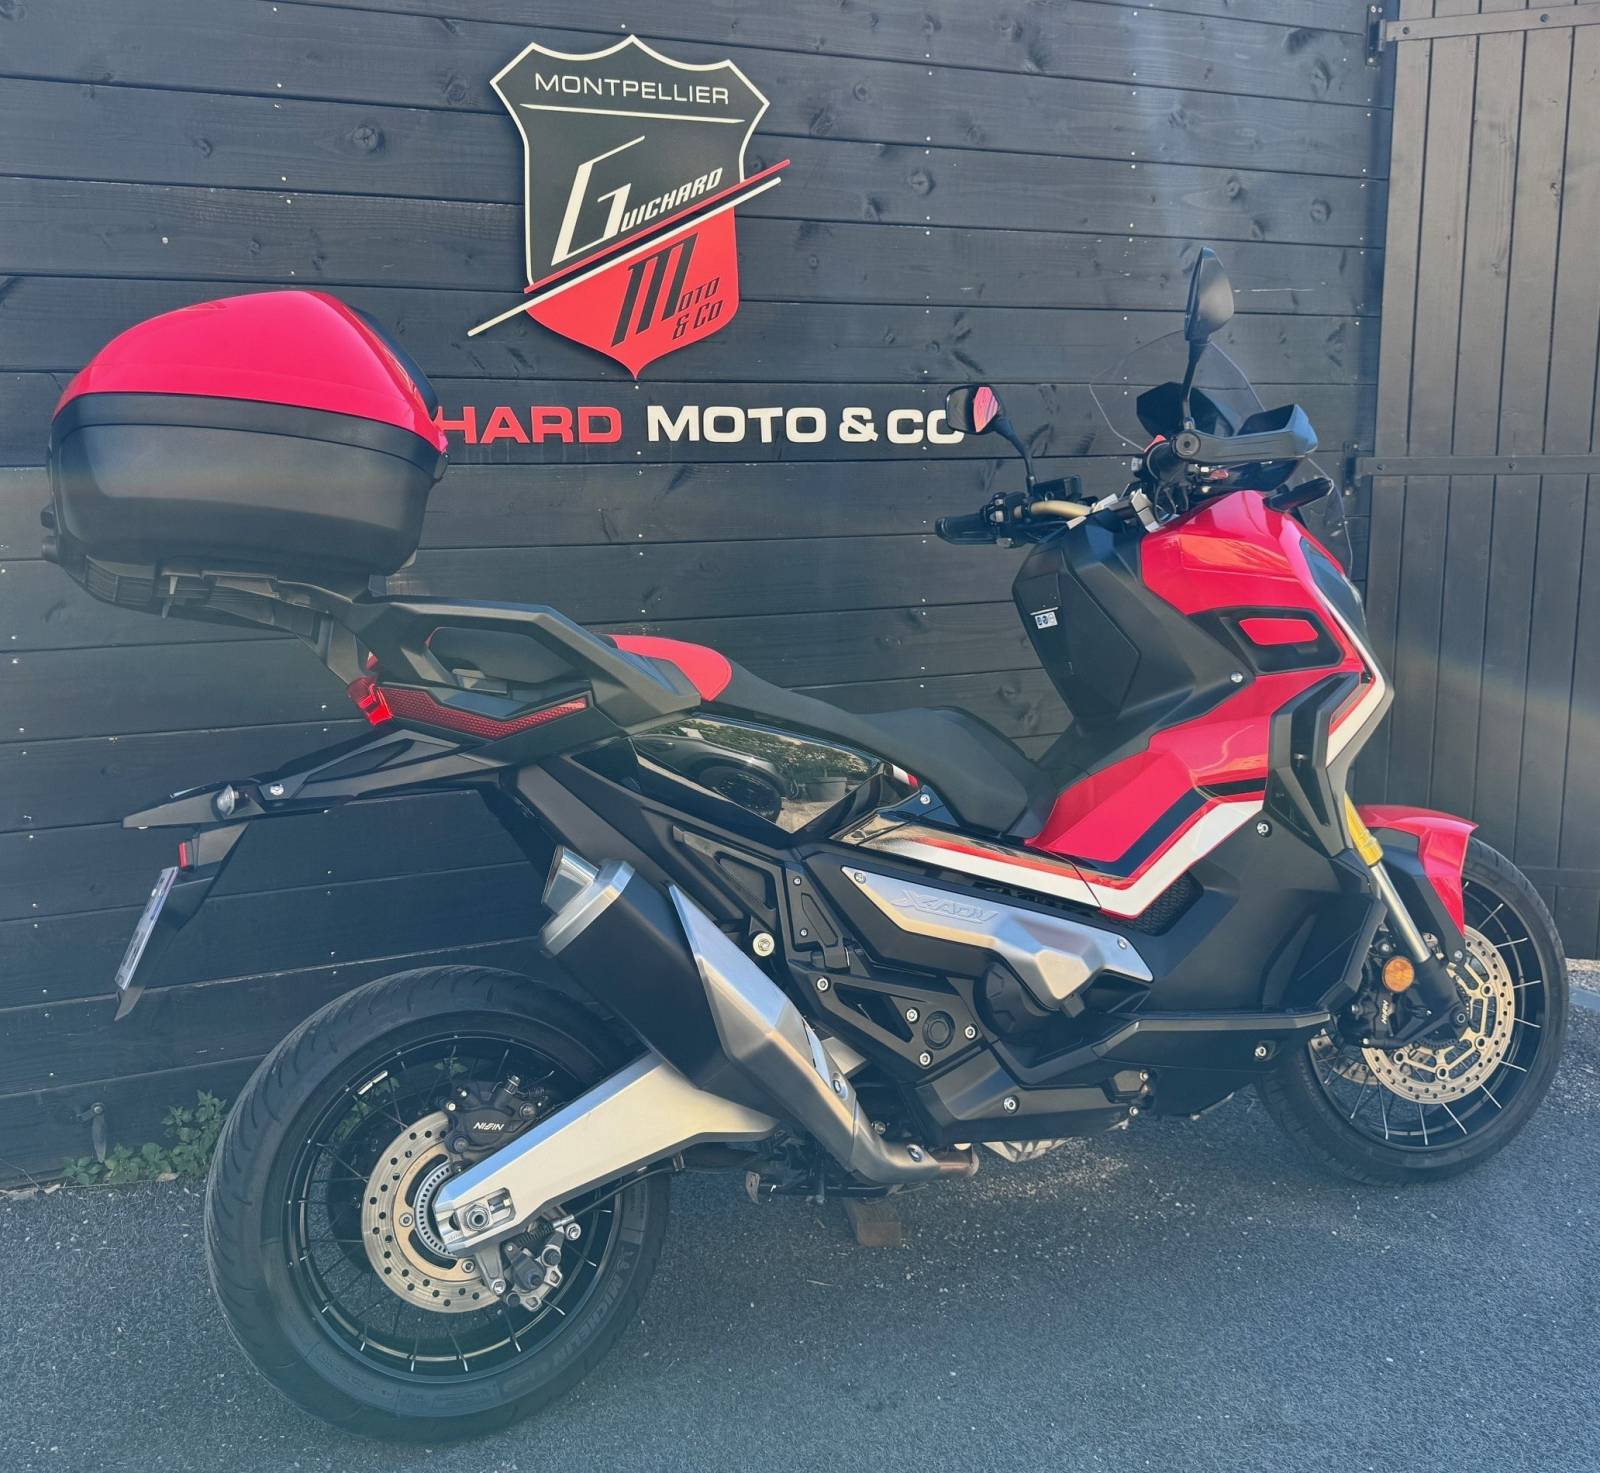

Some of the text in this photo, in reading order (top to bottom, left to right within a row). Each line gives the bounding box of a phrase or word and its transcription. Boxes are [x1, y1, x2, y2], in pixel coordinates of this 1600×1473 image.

[534, 72, 729, 105] MONTPELLIER
[551, 135, 723, 267] GUICHARD
[646, 404, 827, 445] MOTO
[838, 406, 880, 443] &
